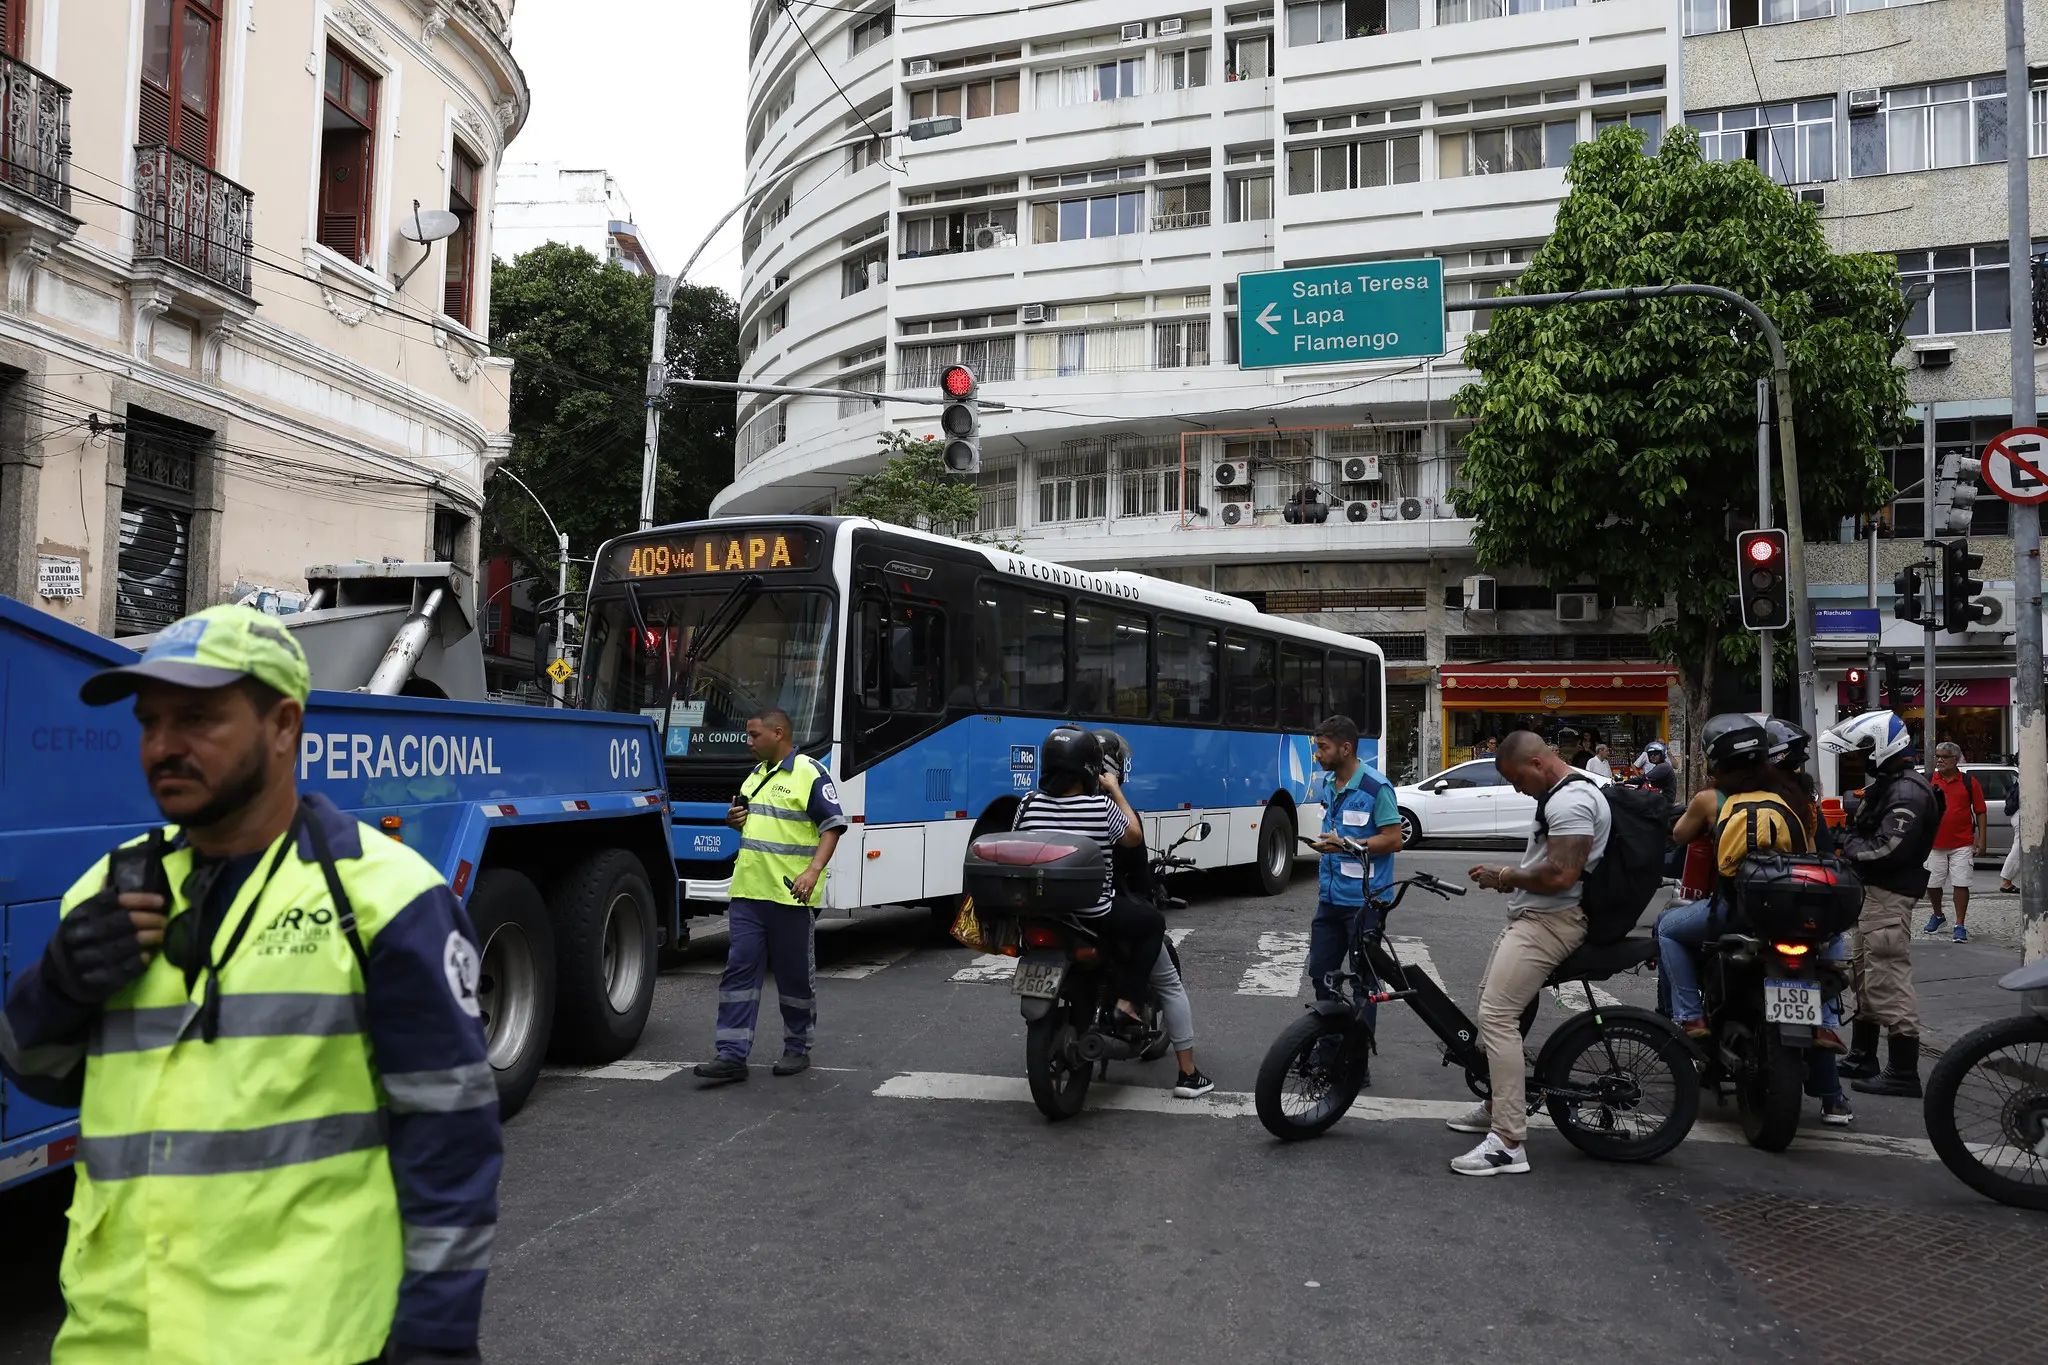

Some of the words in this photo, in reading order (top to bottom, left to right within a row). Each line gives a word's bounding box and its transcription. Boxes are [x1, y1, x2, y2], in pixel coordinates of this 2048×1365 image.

[1293, 280, 1352, 298] Santa
[1358, 276, 1429, 293] Teresa
[1293, 309, 1344, 327] Lapa
[1294, 332, 1399, 351] Flamengo
[628, 547, 670, 576] 409
[672, 549, 694, 568] via
[705, 536, 792, 572] LAPA
[48, 565, 71, 573] VOVÓ
[1008, 558, 1027, 576] AR
[1032, 563, 1140, 600] CONDICIONADO
[1935, 680, 1969, 702] Biju
[31, 727, 121, 751] CET-RIO
[691, 733, 704, 742] AR
[300, 733, 501, 780] PERACIONAL
[610, 738, 641, 779] 013
[1020, 751, 1034, 763] Rio
[1013, 773, 1031, 787] 1746
[693, 835, 721, 846] A71518
[1777, 988, 1809, 1004] LSQ
[1773, 1003, 1815, 1021] 9C56
